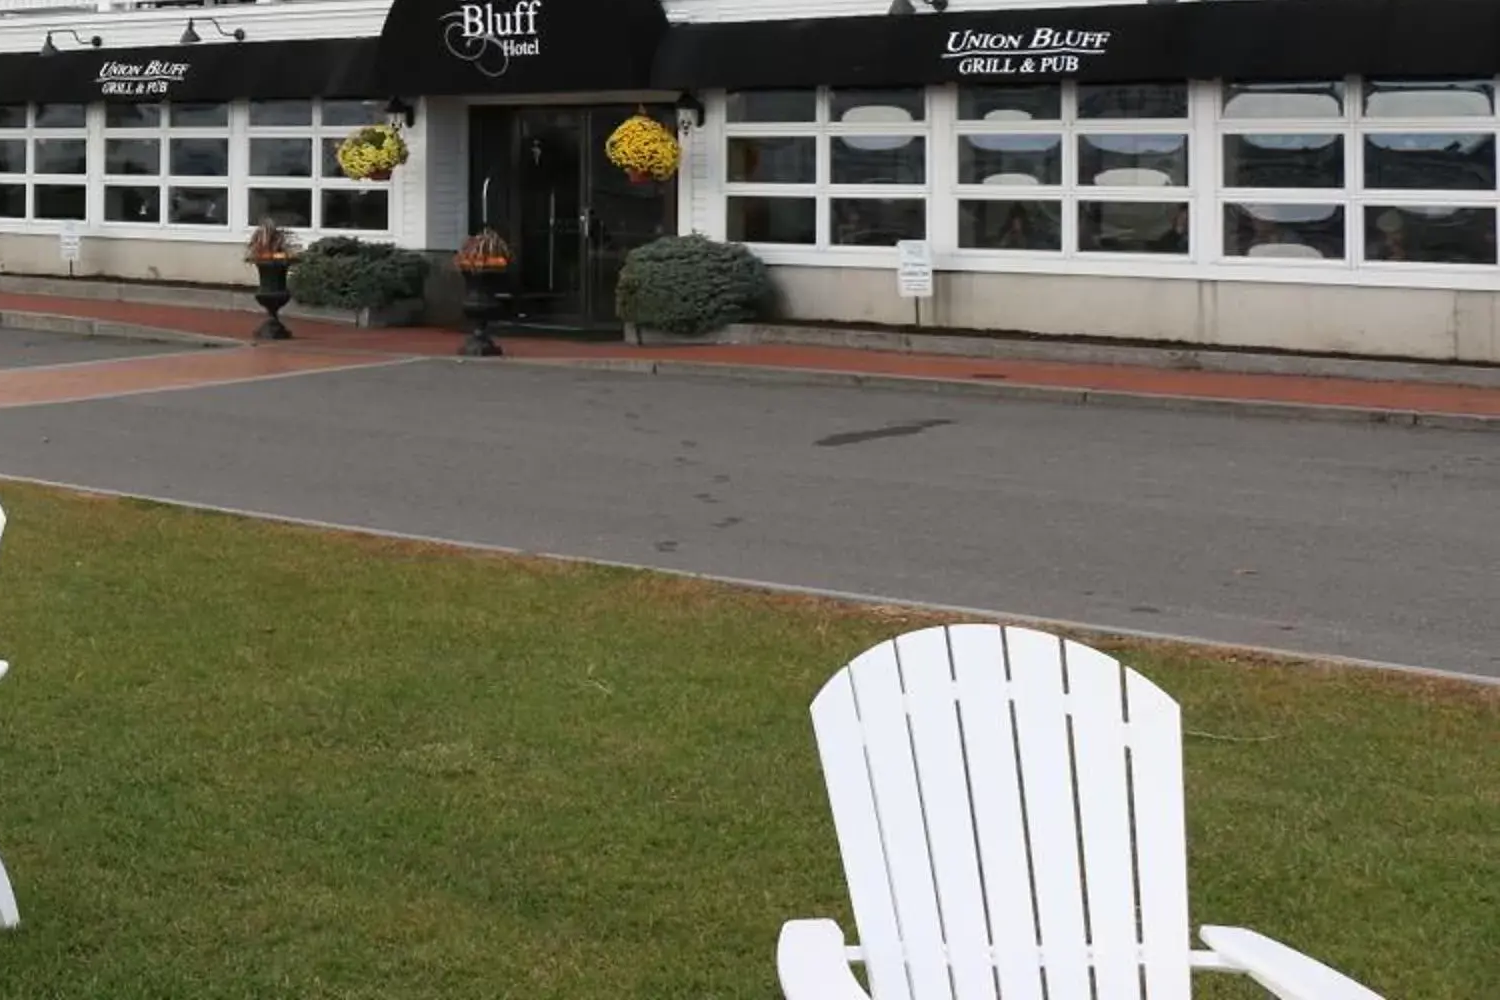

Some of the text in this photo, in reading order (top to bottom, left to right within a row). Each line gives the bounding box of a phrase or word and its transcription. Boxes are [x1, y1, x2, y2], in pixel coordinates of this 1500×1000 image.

[461, 0, 542, 37] Bluff
[503, 38, 540, 56] Hotel
[959, 56, 1079, 74] GRILL & PUB
[146, 81, 169, 94] PUB
